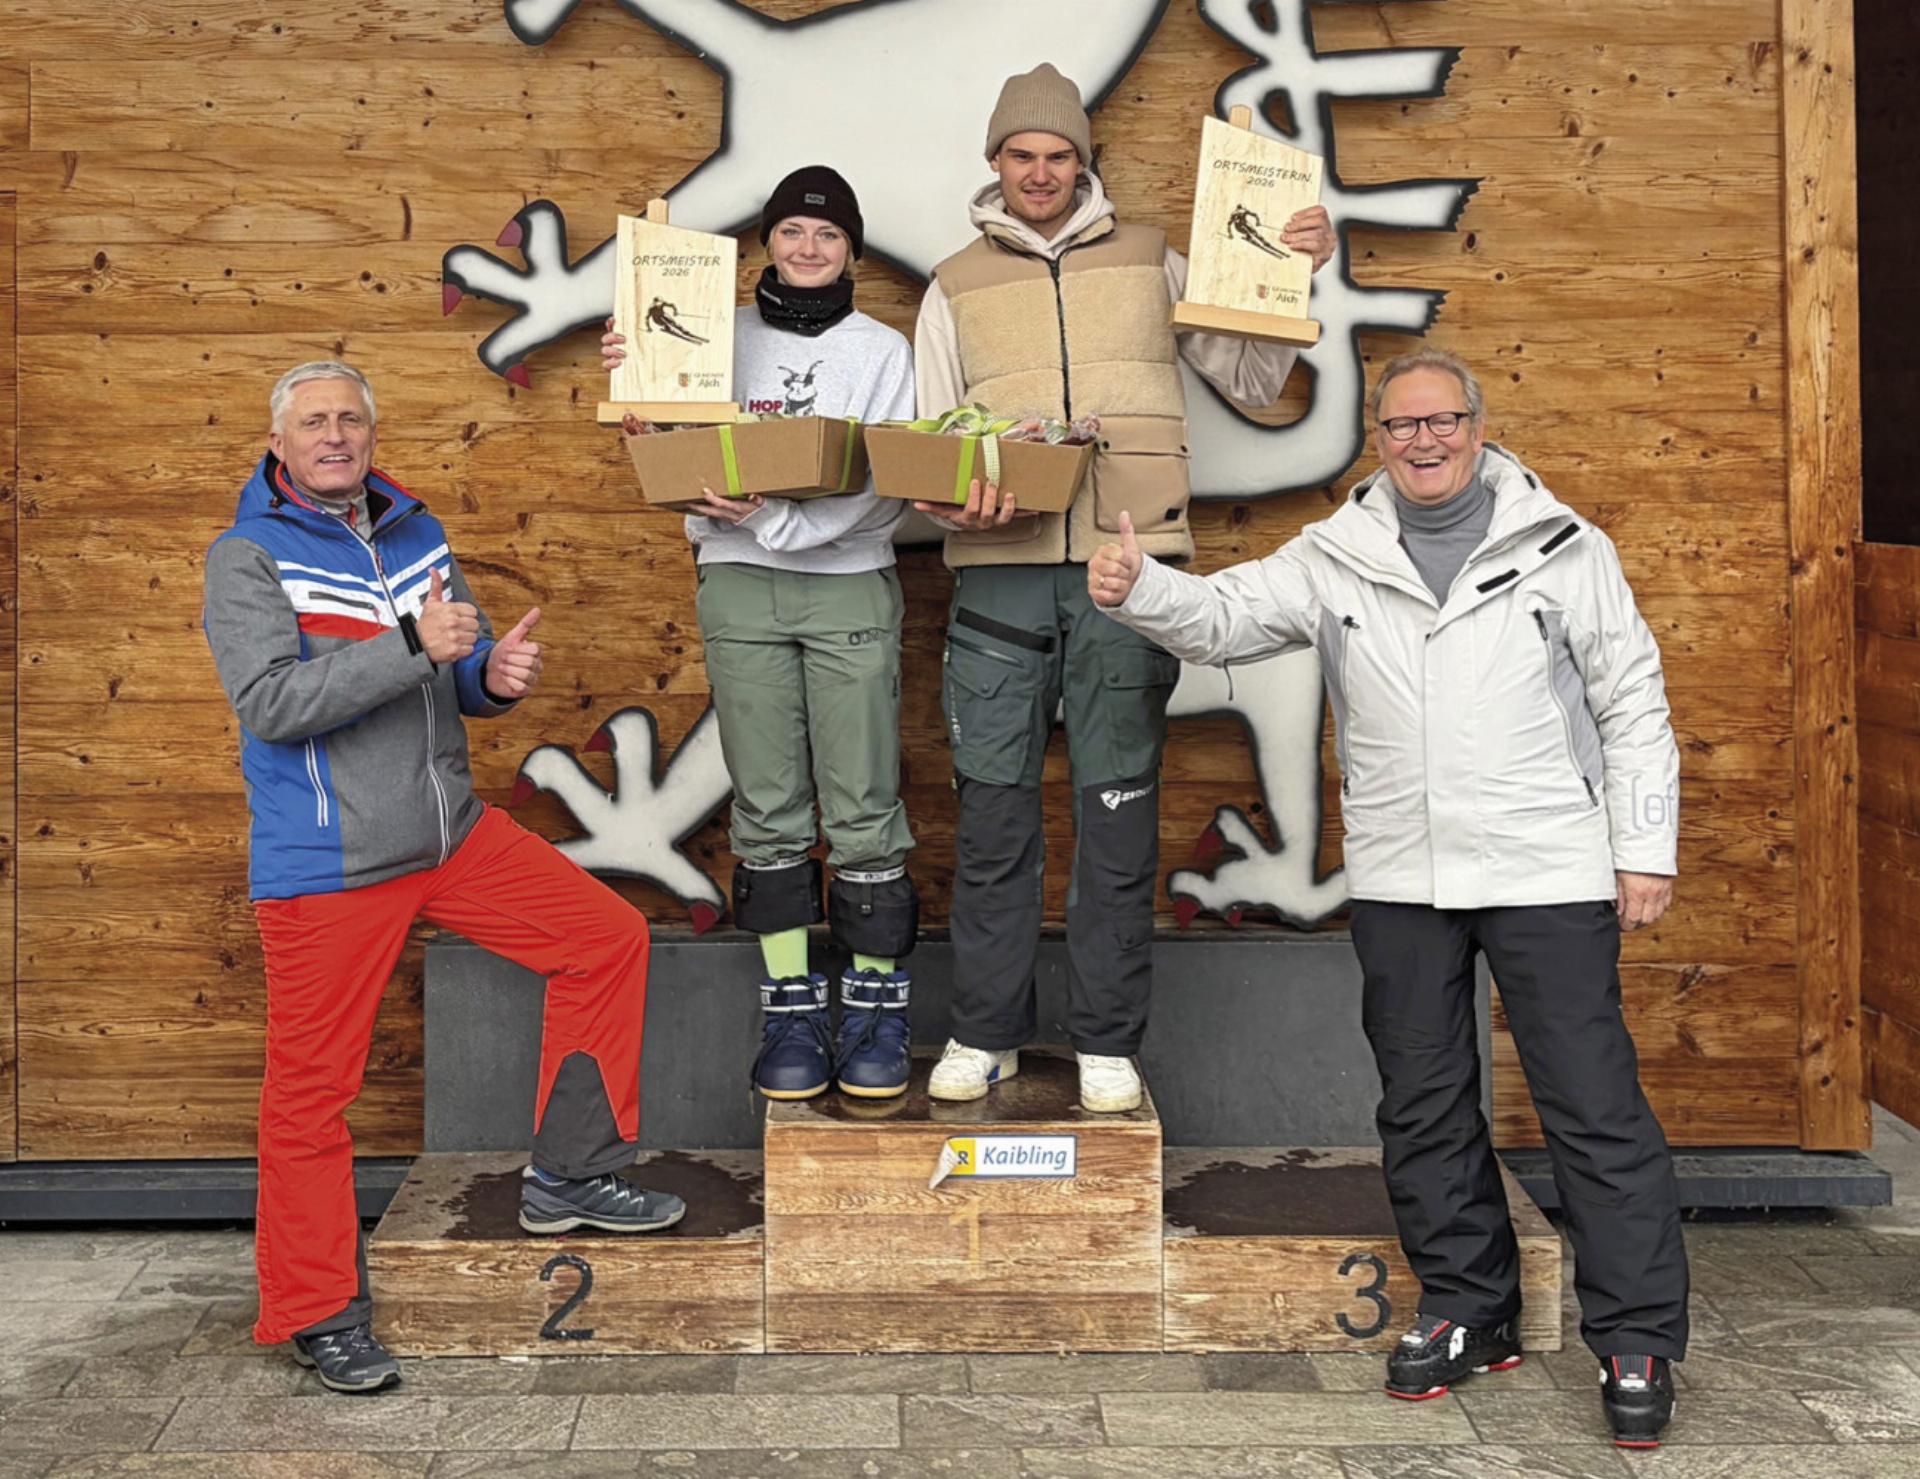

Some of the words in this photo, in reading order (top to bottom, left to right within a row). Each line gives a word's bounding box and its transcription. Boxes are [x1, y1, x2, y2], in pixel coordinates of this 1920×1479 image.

[1247, 176, 1275, 188] 2026
[632, 255, 721, 267] ORTSMEISTER
[662, 268, 690, 277] 2026
[749, 400, 784, 412] HOP
[983, 1146, 1067, 1170] Kaibling
[539, 1254, 594, 1340] 2
[1335, 1253, 1392, 1339] 3
